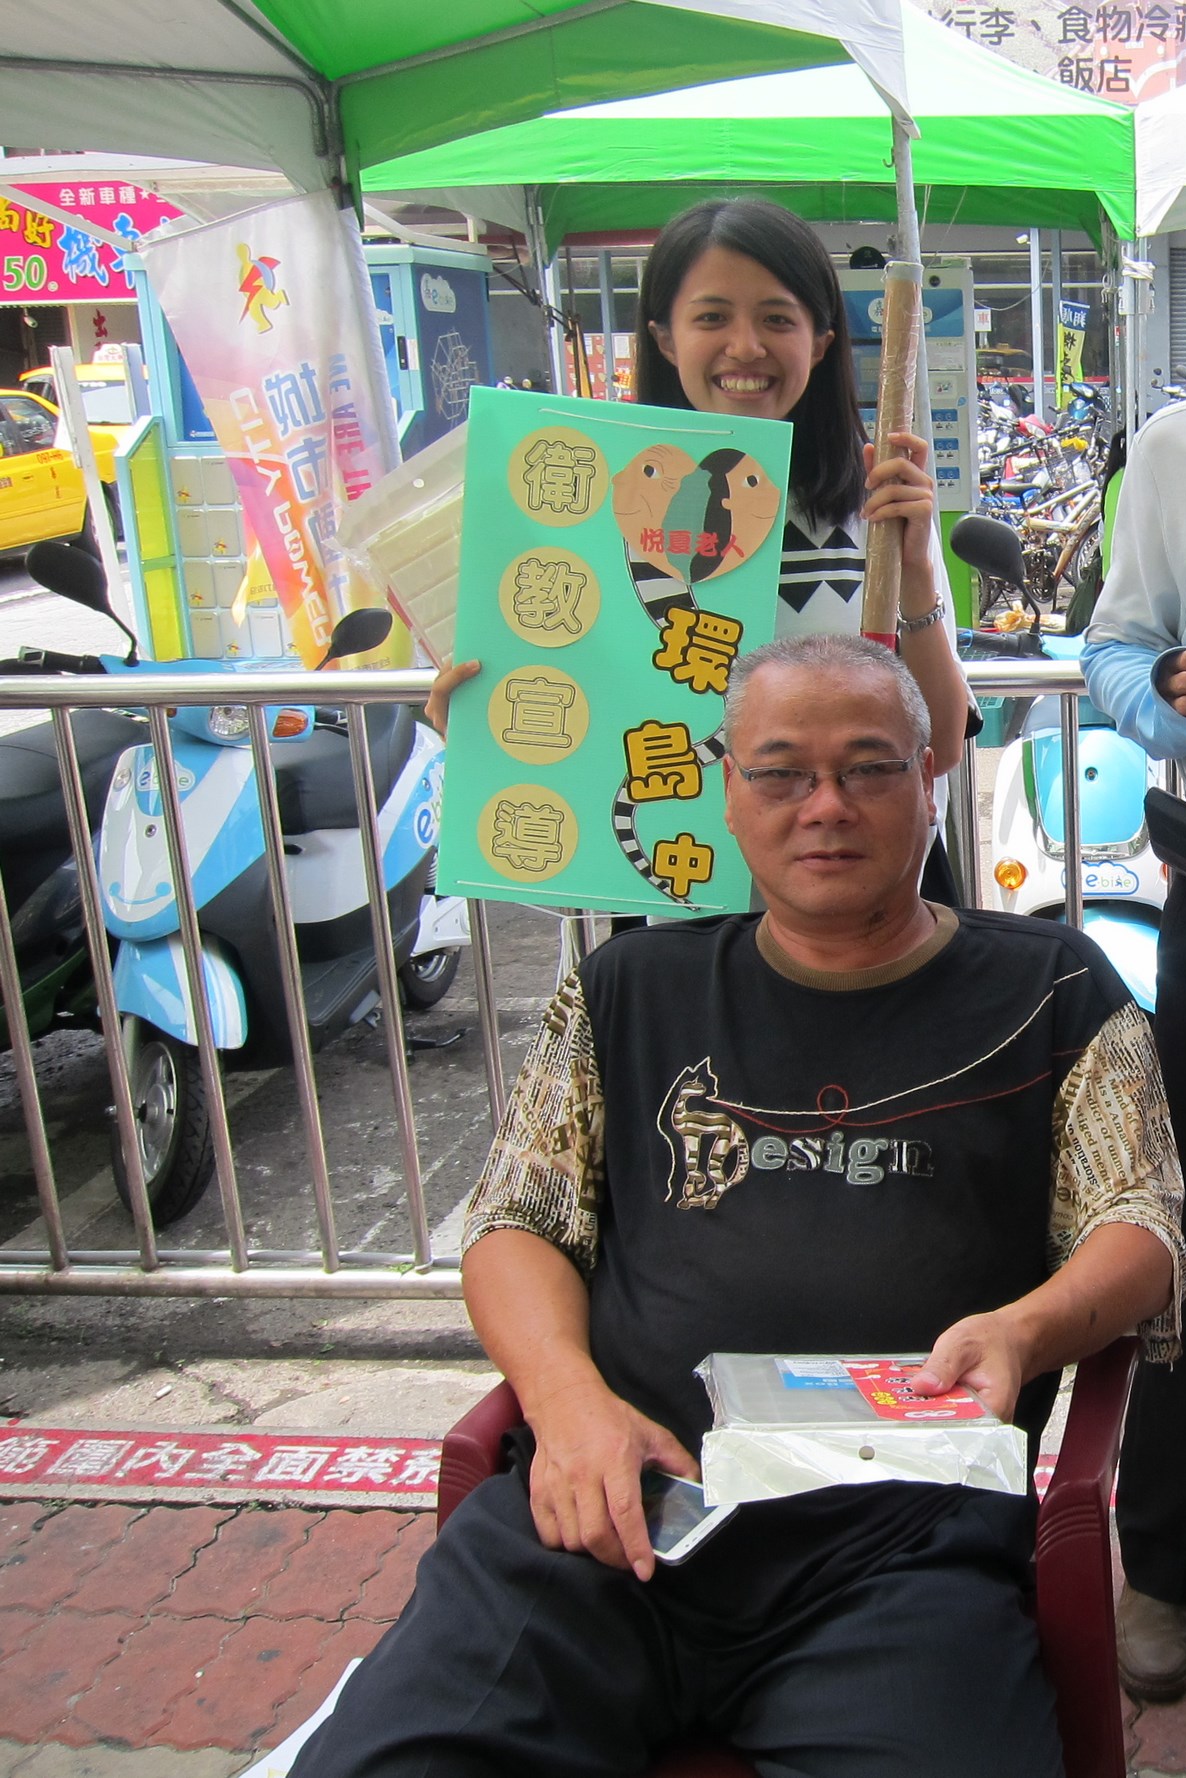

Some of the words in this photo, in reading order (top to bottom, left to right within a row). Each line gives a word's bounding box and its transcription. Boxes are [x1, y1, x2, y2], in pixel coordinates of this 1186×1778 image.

[1057, 56, 1132, 93] 飯店
[59, 186, 136, 206] 全新車種
[492, 439, 597, 872] 衛教宣導
[623, 606, 744, 898] 環島中
